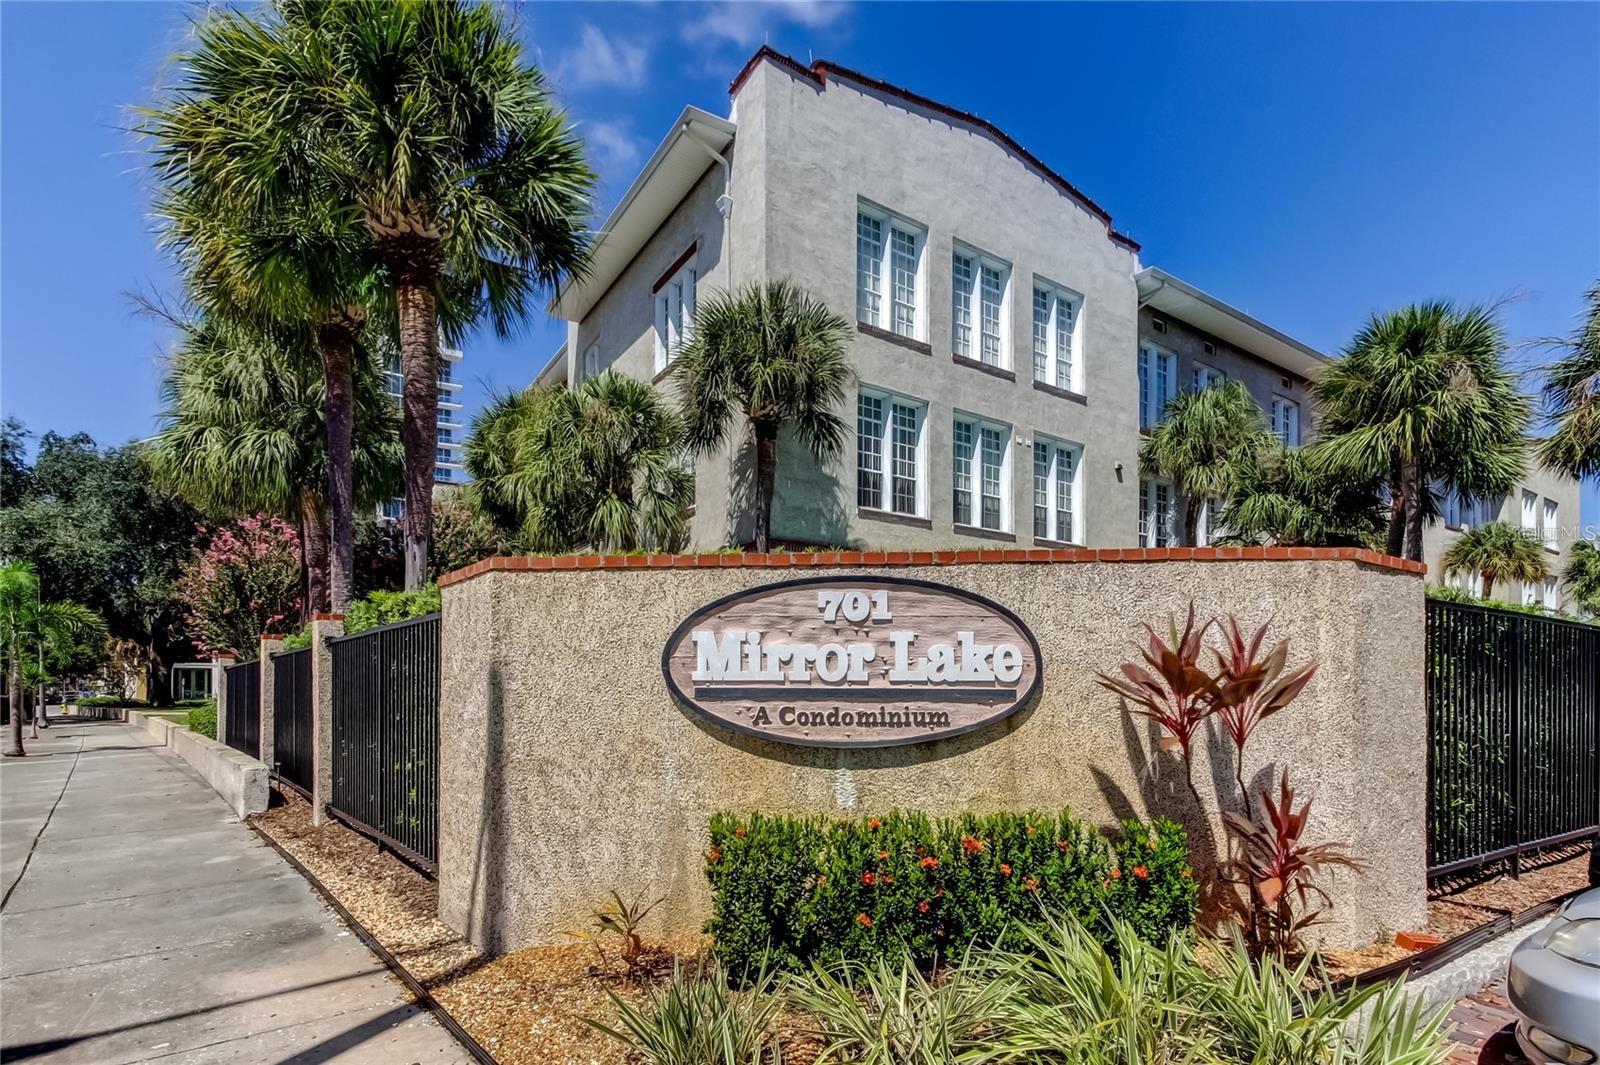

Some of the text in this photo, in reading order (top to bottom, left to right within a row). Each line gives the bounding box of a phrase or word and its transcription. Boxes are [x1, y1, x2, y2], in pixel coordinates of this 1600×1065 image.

[818, 590, 893, 622] 701
[692, 631, 1023, 683] Mirror Lake
[752, 706, 950, 728] A Condominium
